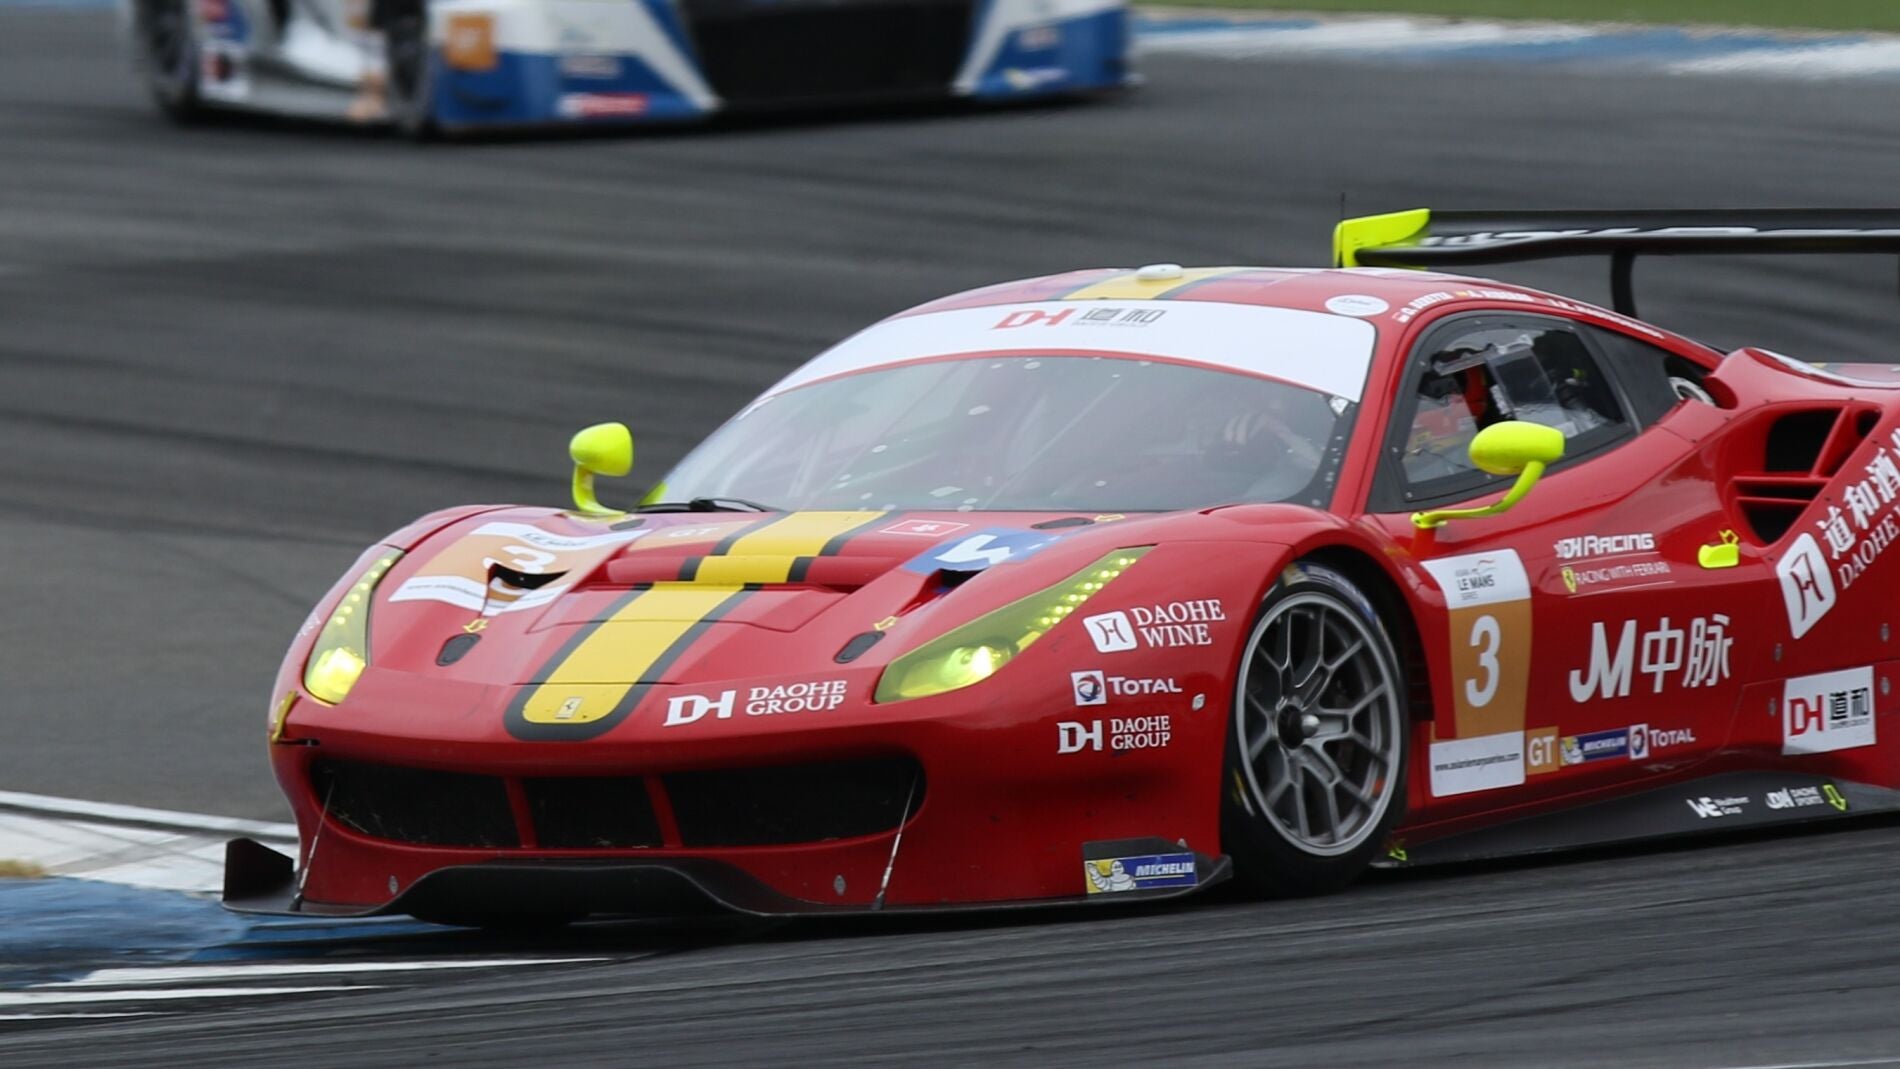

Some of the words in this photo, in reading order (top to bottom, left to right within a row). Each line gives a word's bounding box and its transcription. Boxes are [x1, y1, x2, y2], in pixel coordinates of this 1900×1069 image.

[1131, 599, 1226, 627] DAOHE
[1139, 623, 1212, 648] WINE
[1465, 615, 1500, 708] 3
[1641, 613, 1734, 694] 中脉
[750, 680, 847, 701] DAOHE
[1107, 677, 1183, 695] TOTAL
[746, 695, 844, 716] GROUP
[1789, 694, 1824, 736] DH
[1829, 687, 1869, 721] 道和
[1110, 716, 1171, 734] DAOHE
[1111, 732, 1171, 750] GROUP
[1649, 728, 1696, 747] TOTAL
[1528, 735, 1555, 766] GT
[1135, 862, 1195, 877] MICHELIN
